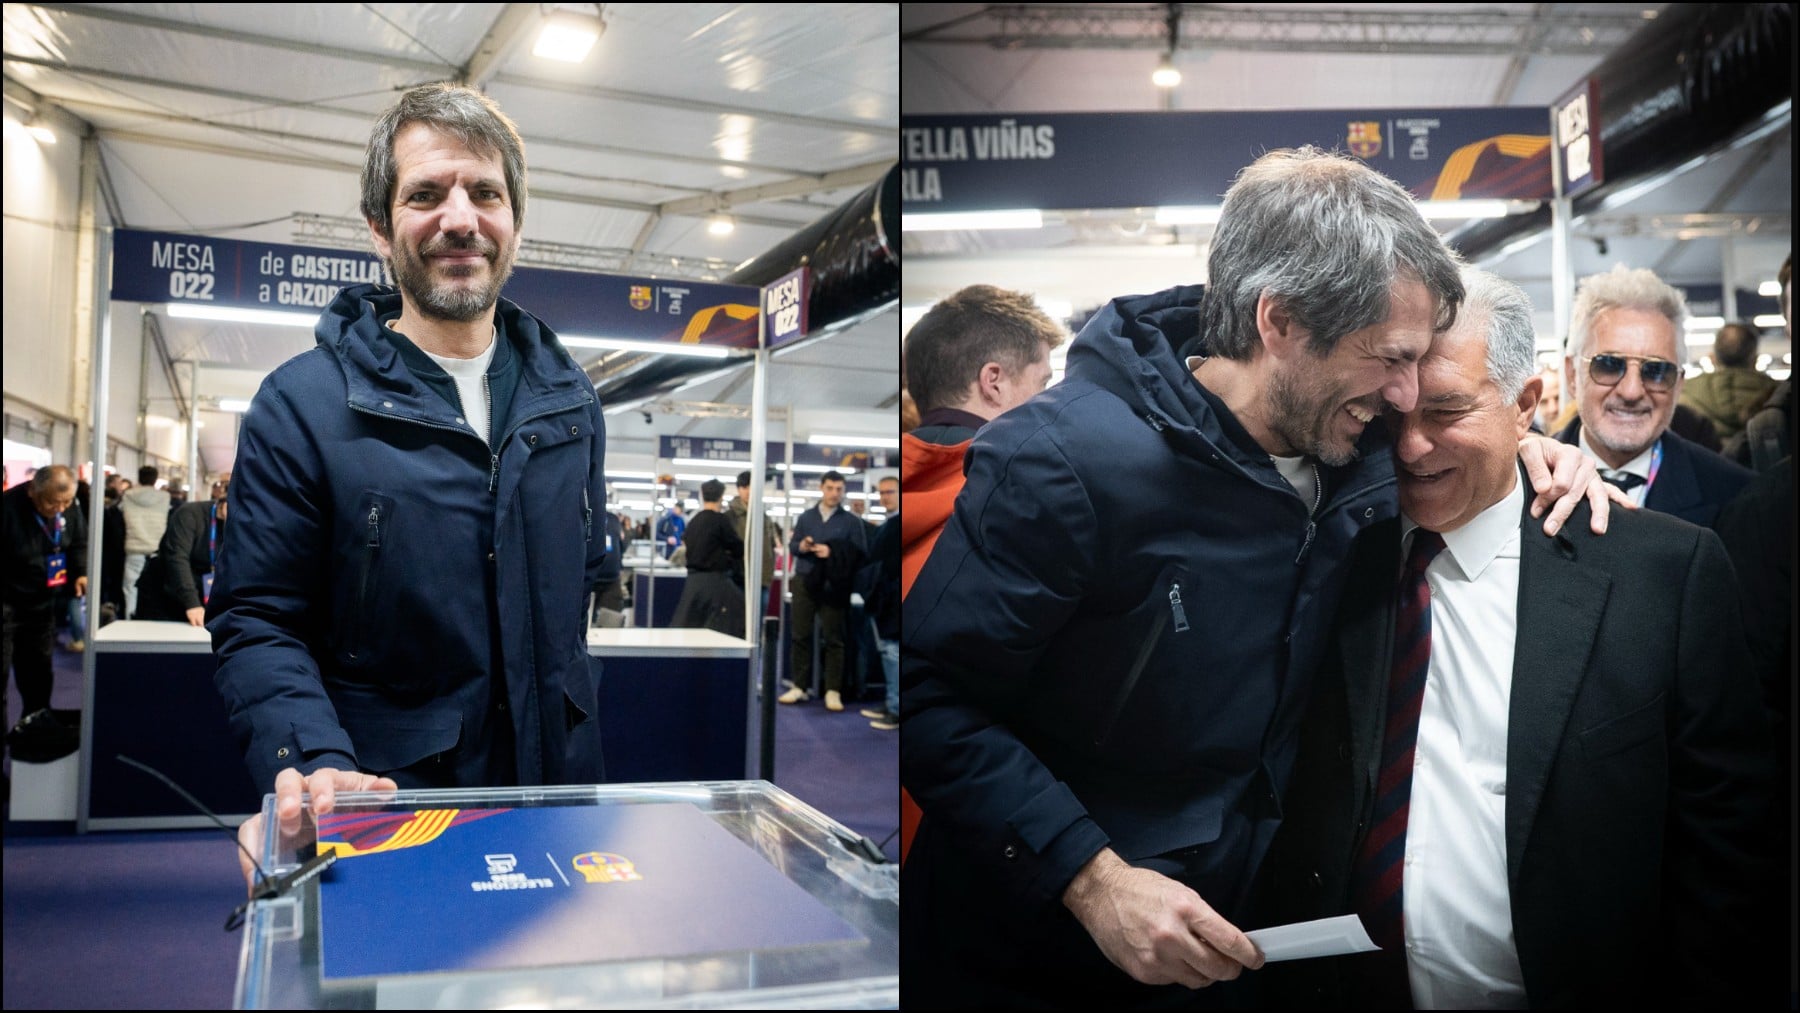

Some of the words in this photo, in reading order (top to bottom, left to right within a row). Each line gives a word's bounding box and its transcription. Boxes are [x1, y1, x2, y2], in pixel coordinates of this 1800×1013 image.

[972, 119, 1055, 160] VIÑAS
[152, 241, 215, 272] MESA
[260, 251, 285, 276] de
[291, 254, 381, 284] CASTELLA
[169, 271, 215, 300] 022
[259, 284, 271, 303] a
[767, 277, 799, 315] MESA
[775, 303, 799, 337] 022
